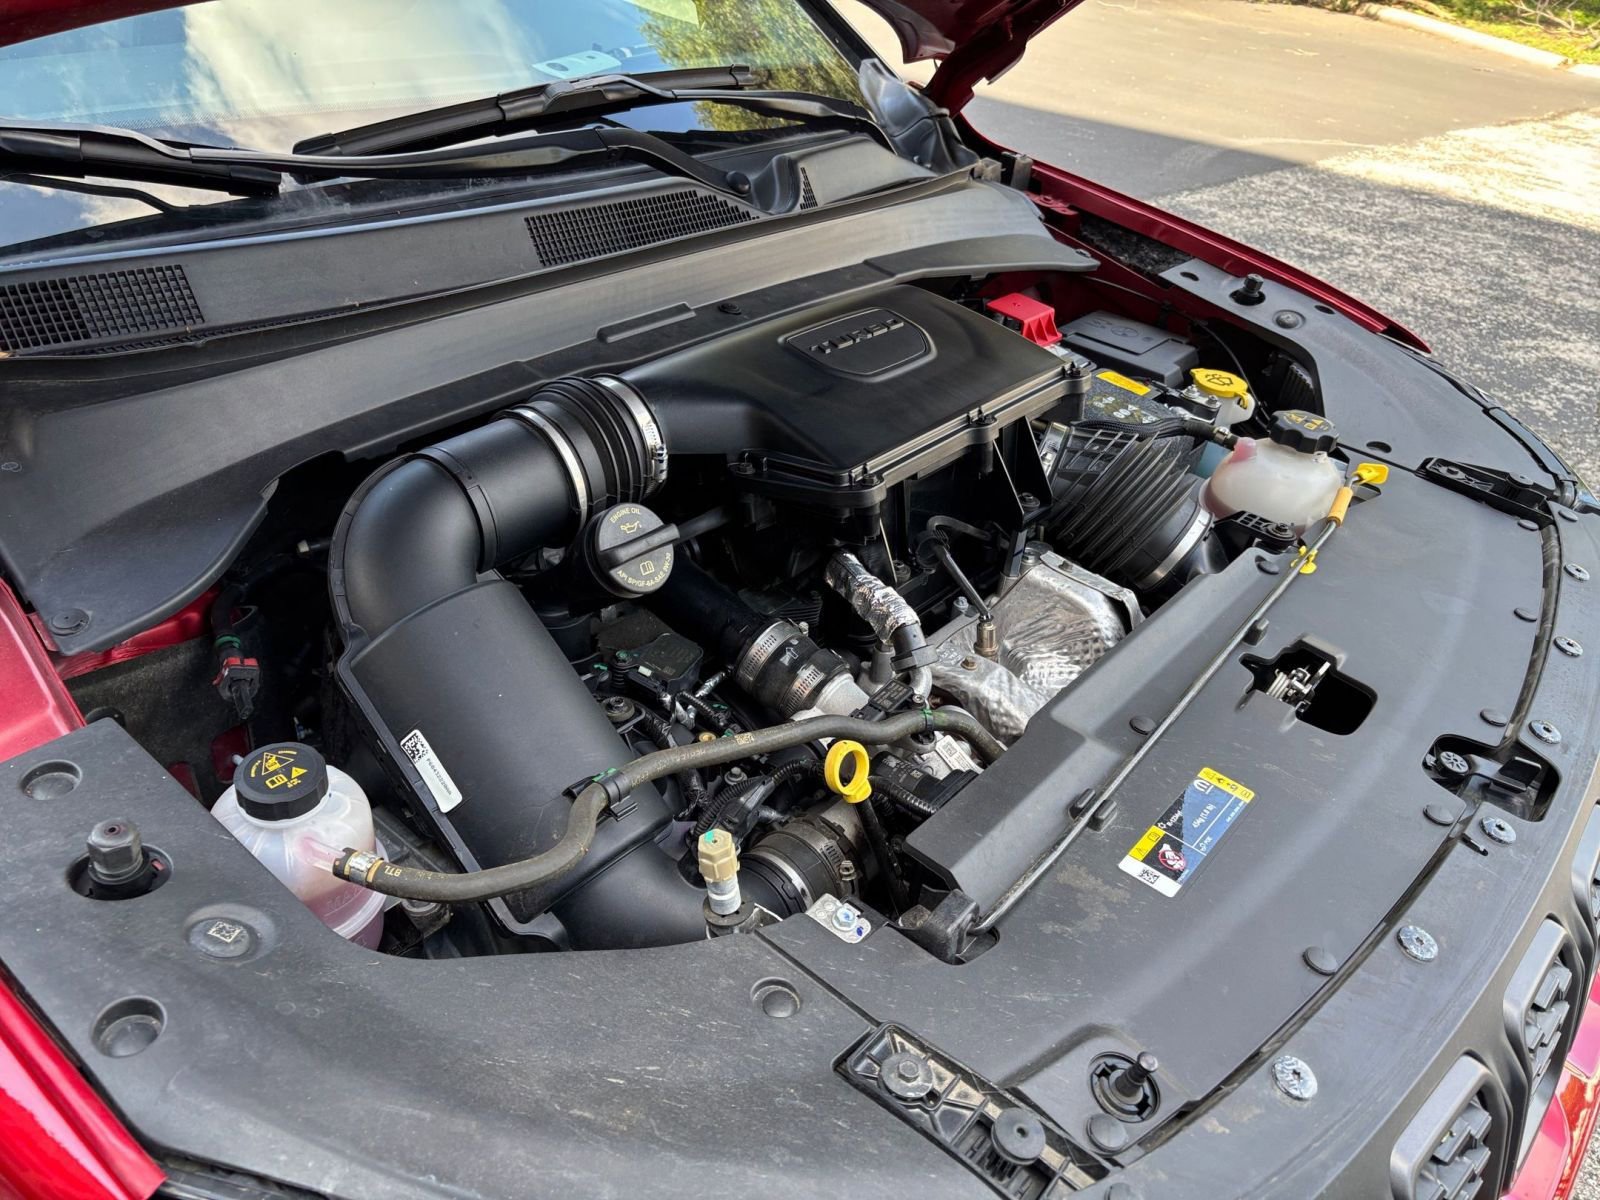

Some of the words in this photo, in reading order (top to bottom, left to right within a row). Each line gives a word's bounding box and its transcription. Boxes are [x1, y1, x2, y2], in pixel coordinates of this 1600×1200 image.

[809, 319, 904, 354] TURBO
[610, 508, 630, 523] ENGINE
[631, 507, 641, 515] OIL
[617, 570, 628, 581] API
